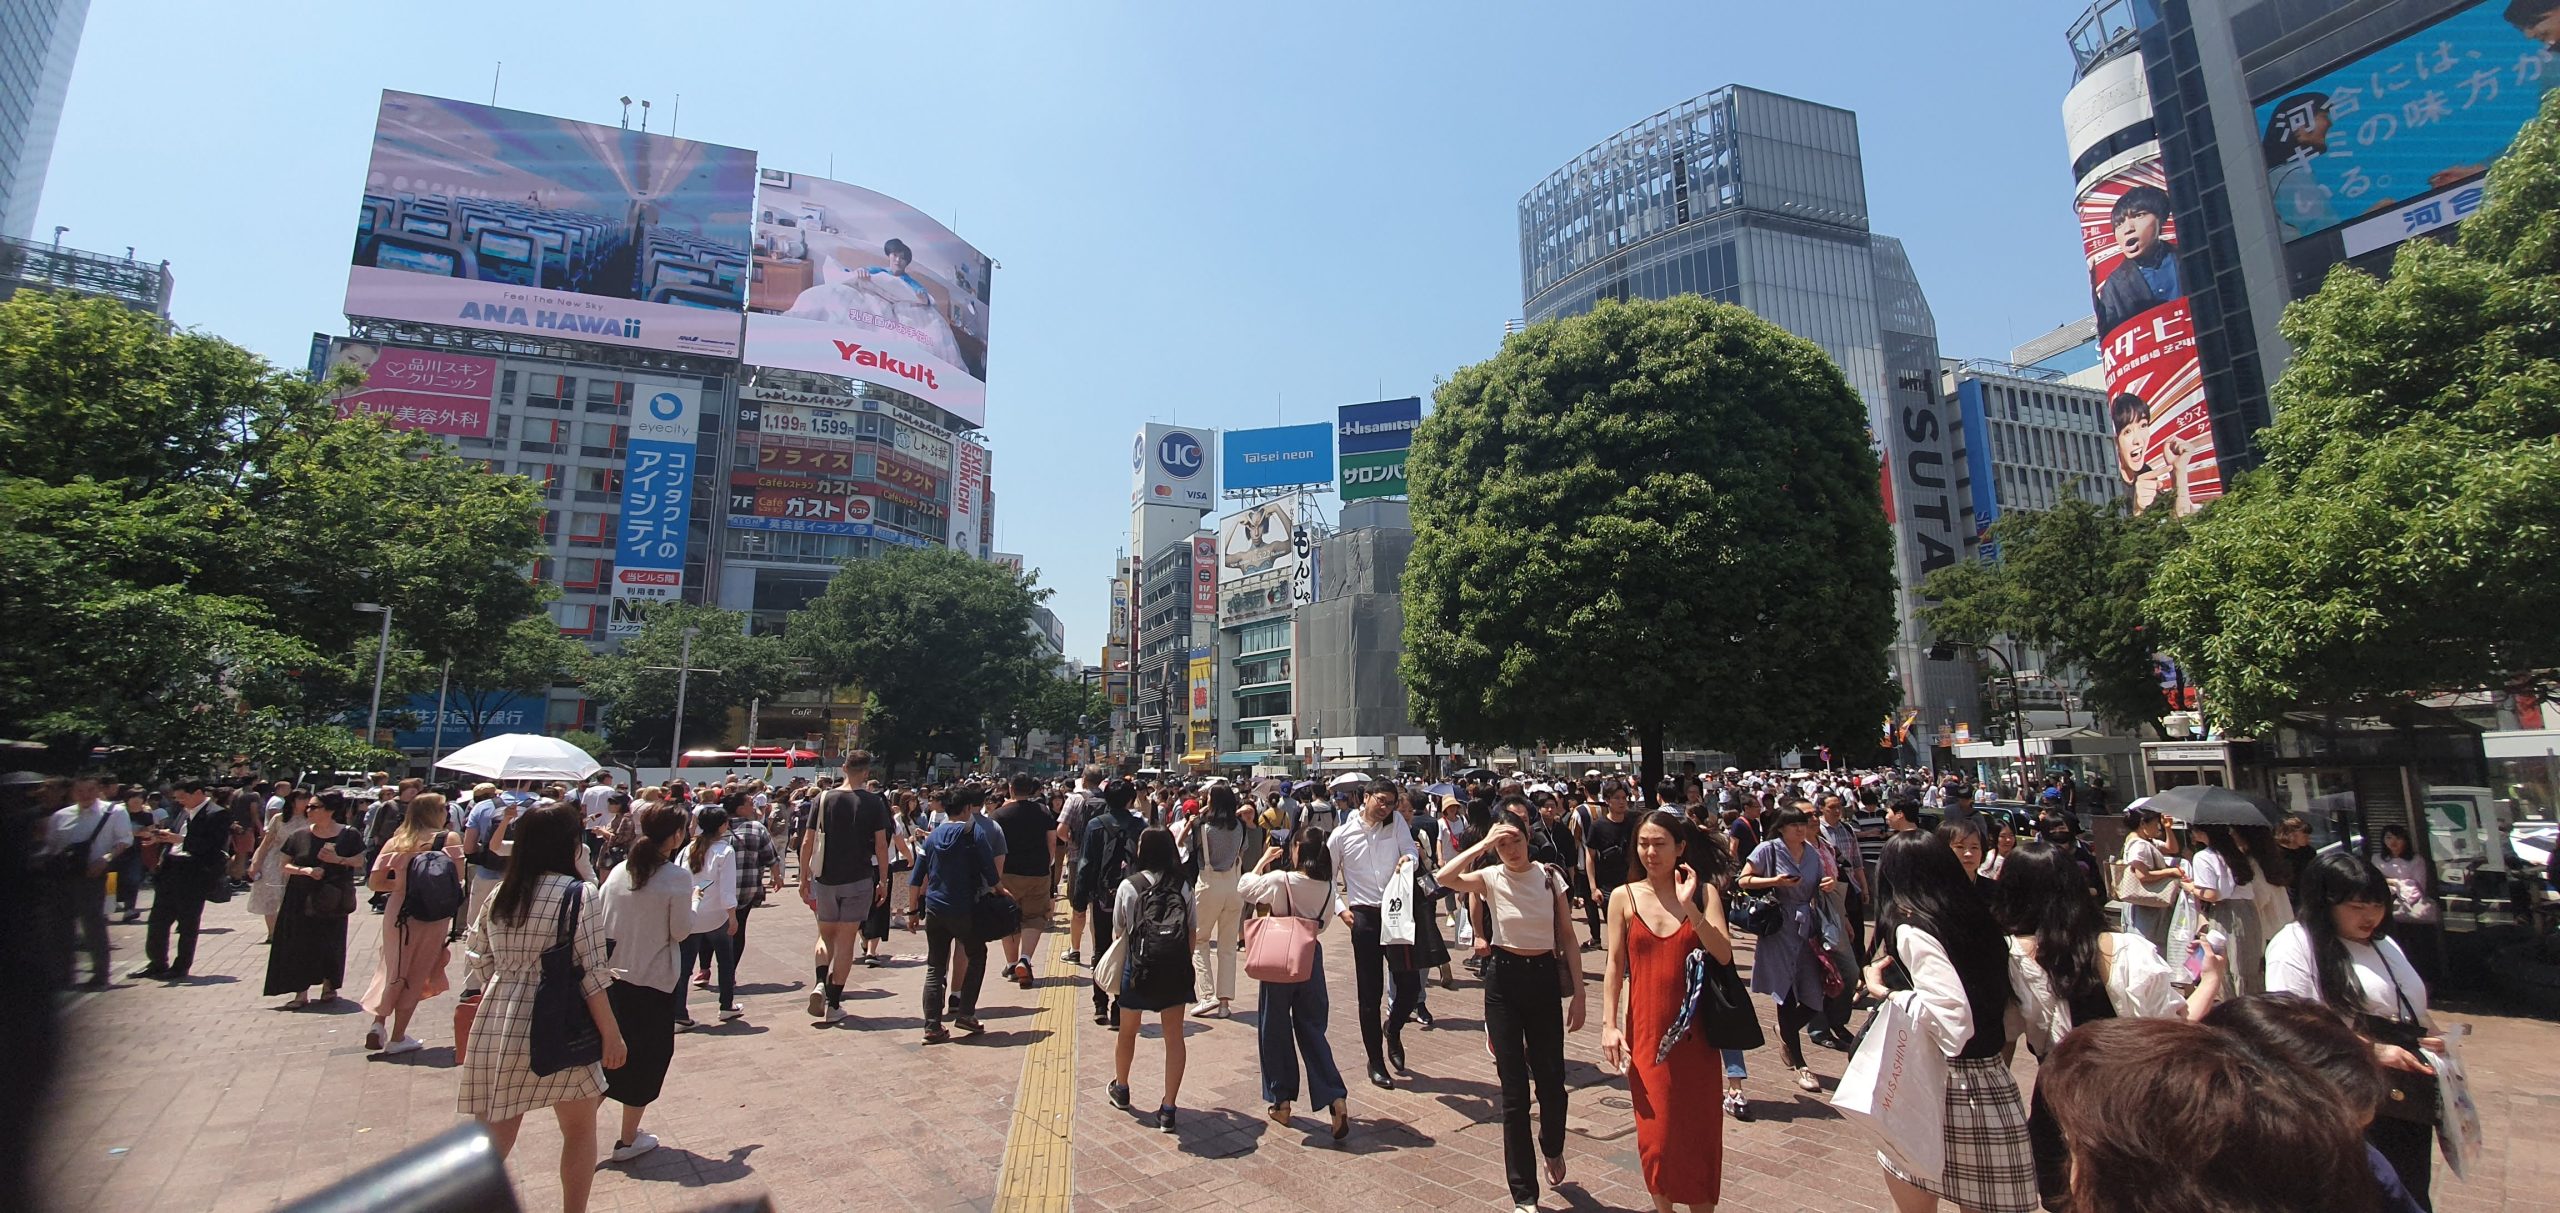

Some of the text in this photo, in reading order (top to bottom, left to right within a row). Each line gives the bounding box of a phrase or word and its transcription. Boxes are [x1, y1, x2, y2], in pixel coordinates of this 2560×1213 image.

[503, 291, 529, 302] Feel
[532, 294, 553, 305] The
[556, 297, 581, 308] New
[459, 301, 642, 339] ANA HAWAii
[408, 357, 488, 377] 品川スキン
[832, 339, 939, 390] Yakult
[407, 372, 478, 391] クリニック
[740, 409, 760, 421] 9F
[638, 421, 689, 436] eyecity
[1339, 418, 1419, 436] Hisamitsu
[1162, 441, 1200, 468] UC
[1242, 449, 1314, 464] Taisei neon
[876, 459, 934, 491] コンタクト
[958, 440, 972, 515] SHOKICHI
[970, 445, 983, 490] EXILE
[1342, 463, 1407, 485] サロンパ
[816, 479, 859, 496] ガスト
[1186, 490, 1208, 500] VISA
[627, 450, 663, 558] アイシティ
[657, 452, 687, 559] コンタクトの
[731, 495, 754, 509] 7F
[784, 497, 841, 519] ガスト
[1293, 525, 1311, 605] もんじゃ
[791, 706, 812, 717] Café
[1881, 1029, 1908, 1112] MUSASHINO
